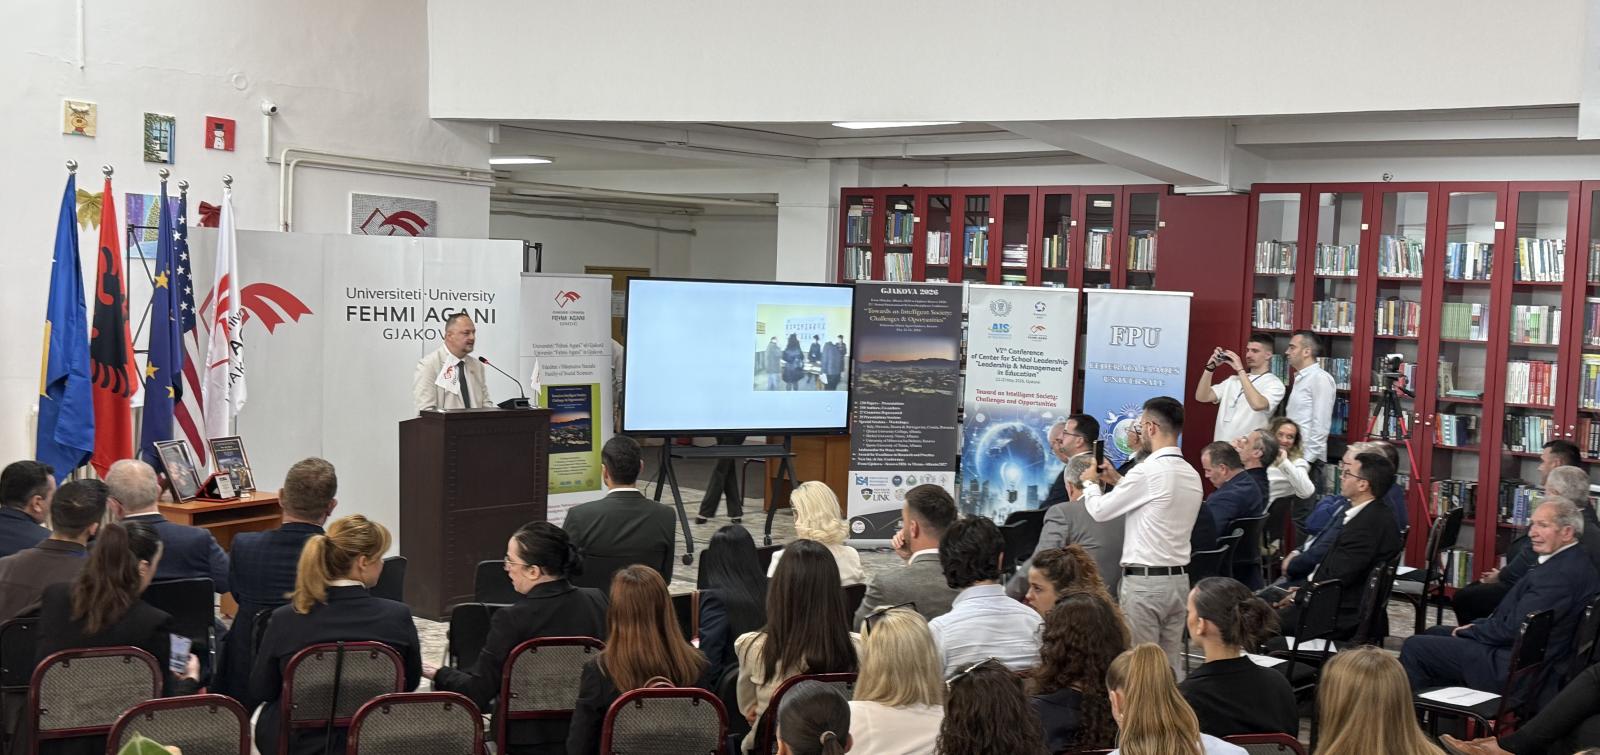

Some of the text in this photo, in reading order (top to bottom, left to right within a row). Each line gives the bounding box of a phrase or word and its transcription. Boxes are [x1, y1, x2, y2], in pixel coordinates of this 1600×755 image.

[346, 287, 496, 304] Universiteti University
[880, 287, 939, 296] GJAKOVA 2026
[346, 306, 415, 322] FEHMI
[901, 308, 929, 316] Intelligent
[383, 328, 446, 340] GJAKOV
[1109, 326, 1162, 349] FPU
[1008, 348, 1044, 356] Conference
[979, 353, 999, 361] Center
[1011, 355, 1033, 363] School
[1033, 357, 1069, 366] Leadership
[1020, 364, 1063, 373] Management
[976, 396, 1006, 404] Challenges
[1018, 399, 1057, 408] Opportunities
